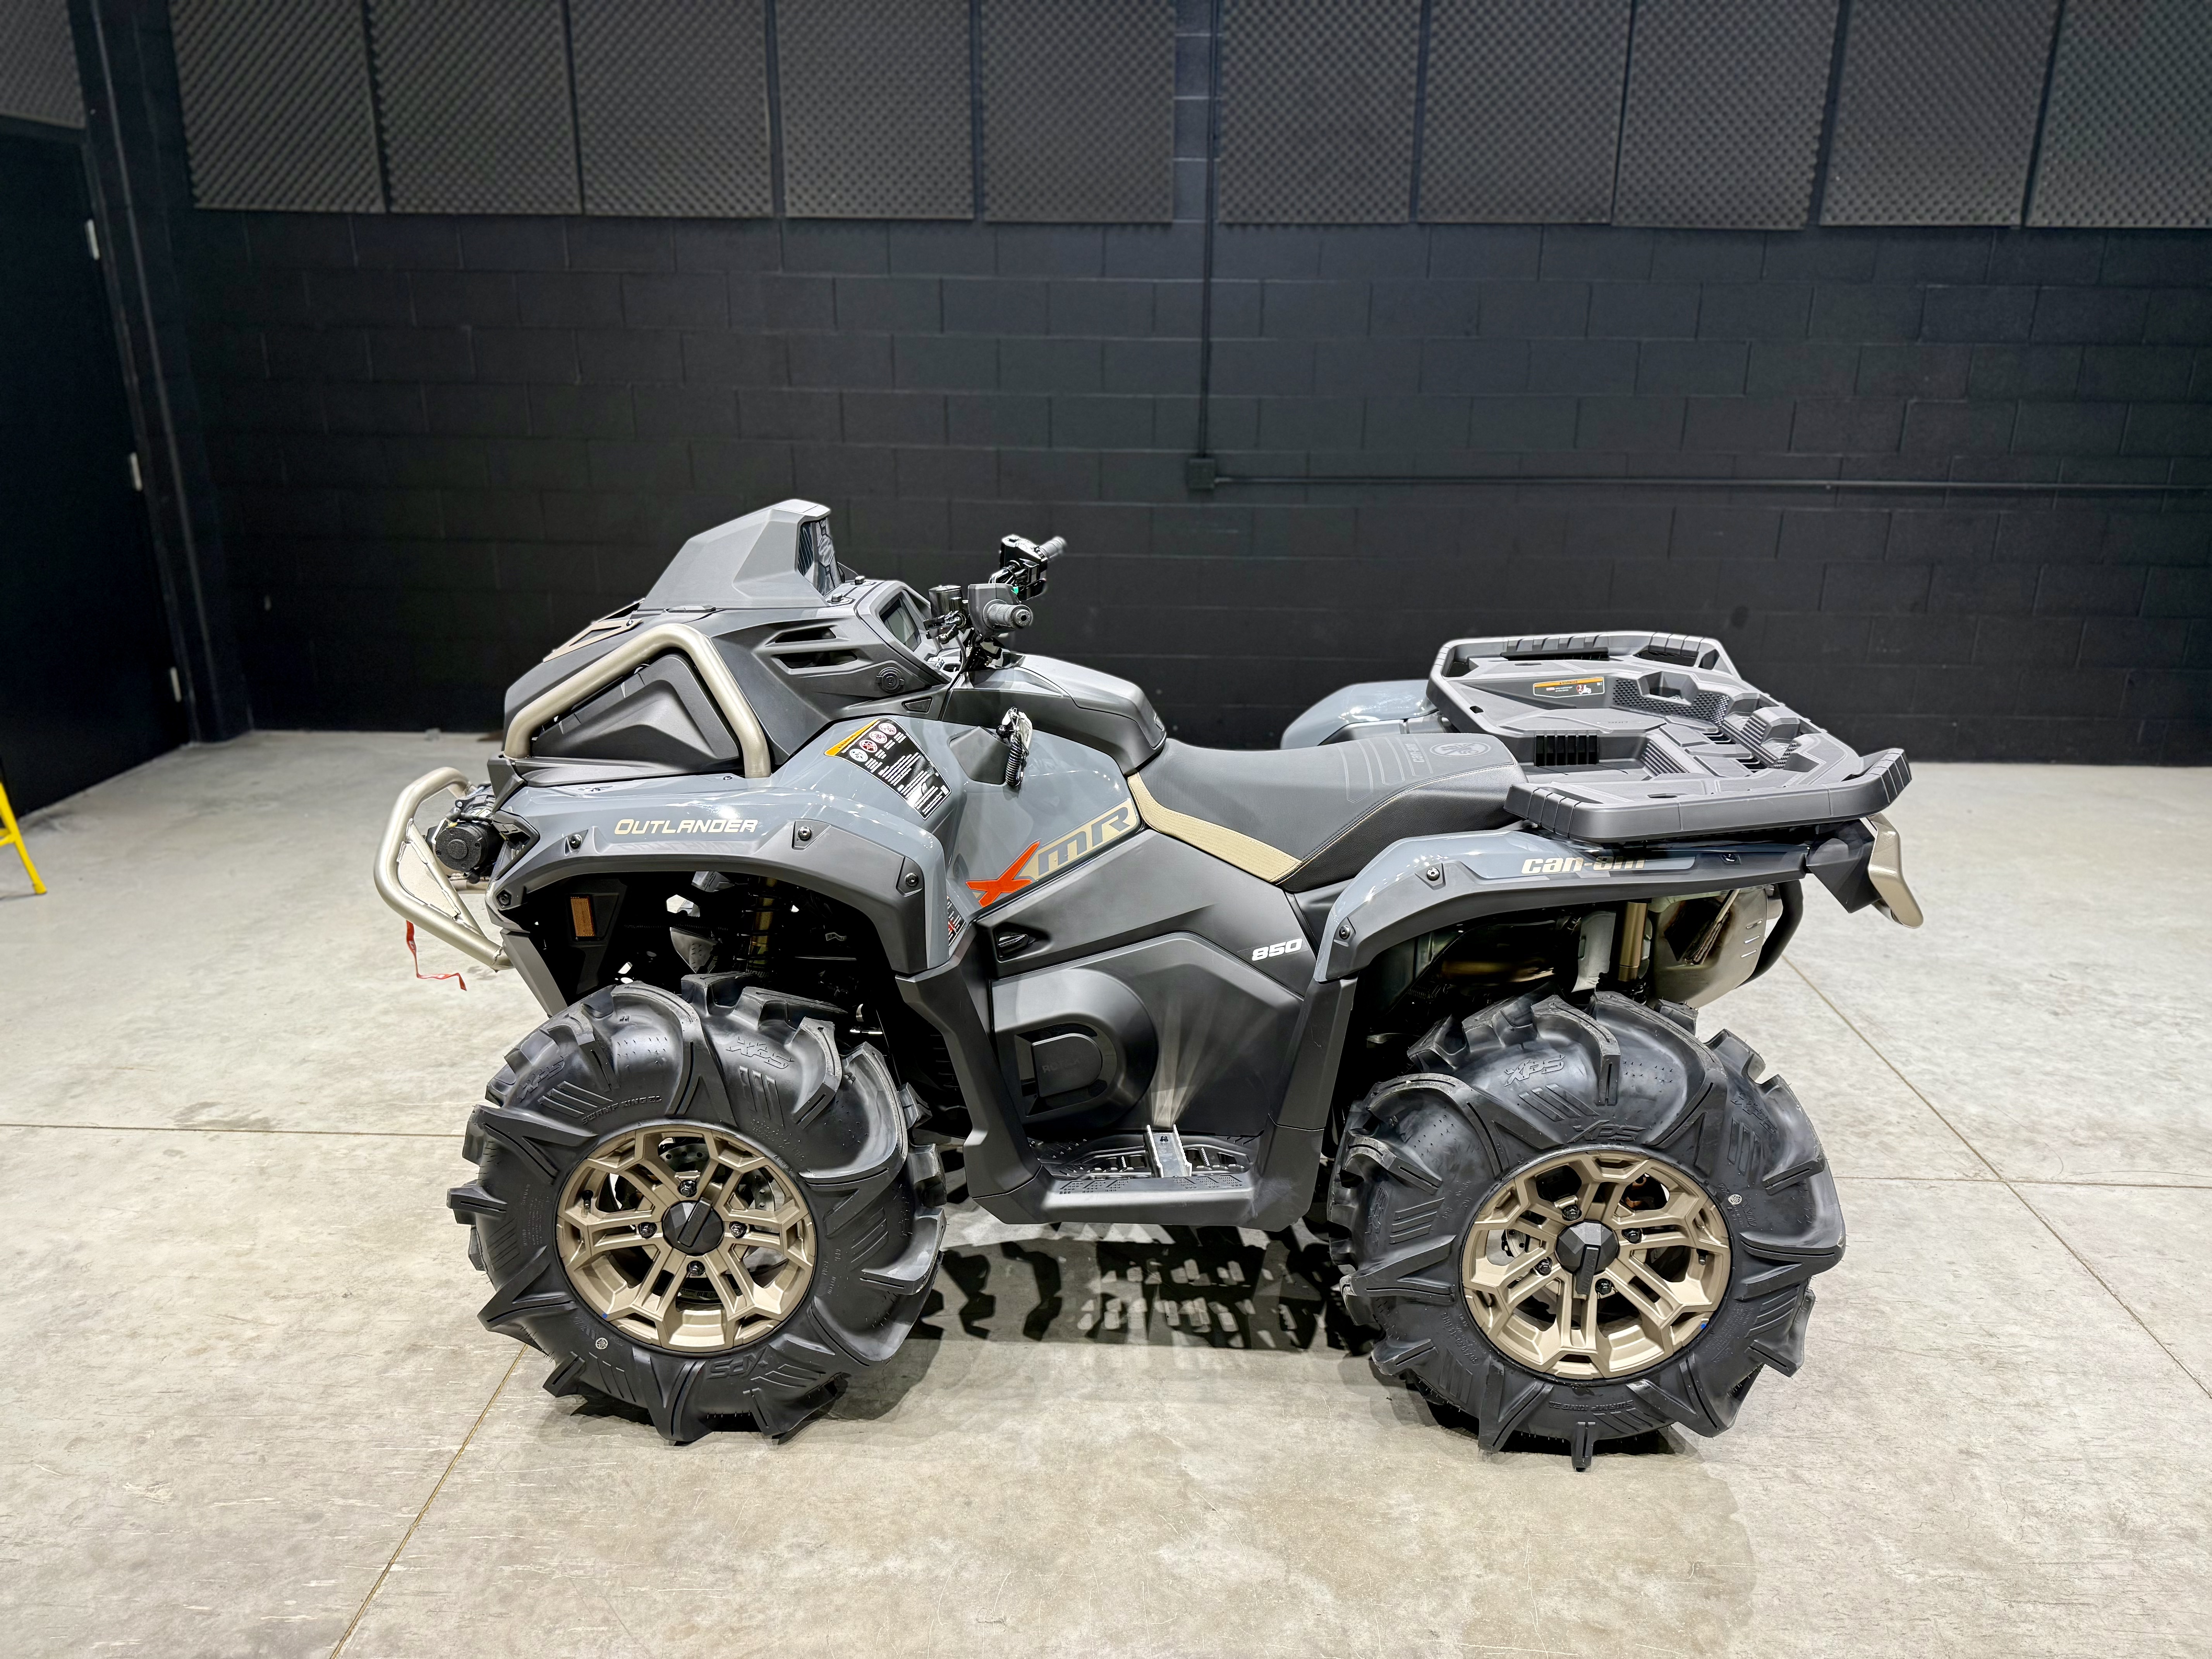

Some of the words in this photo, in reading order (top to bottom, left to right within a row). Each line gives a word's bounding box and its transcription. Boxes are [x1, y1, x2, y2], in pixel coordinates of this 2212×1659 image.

[615, 819, 758, 835] OUTLANDER
[1521, 856, 1645, 874] can-am
[1252, 938, 1302, 961] 850
[726, 1036, 794, 1069] XPS
[1504, 1055, 1565, 1087] XPS
[582, 1103, 619, 1125] SWAMP
[1567, 1120, 1646, 1143] XPS
[706, 1345, 768, 1379] XPS
